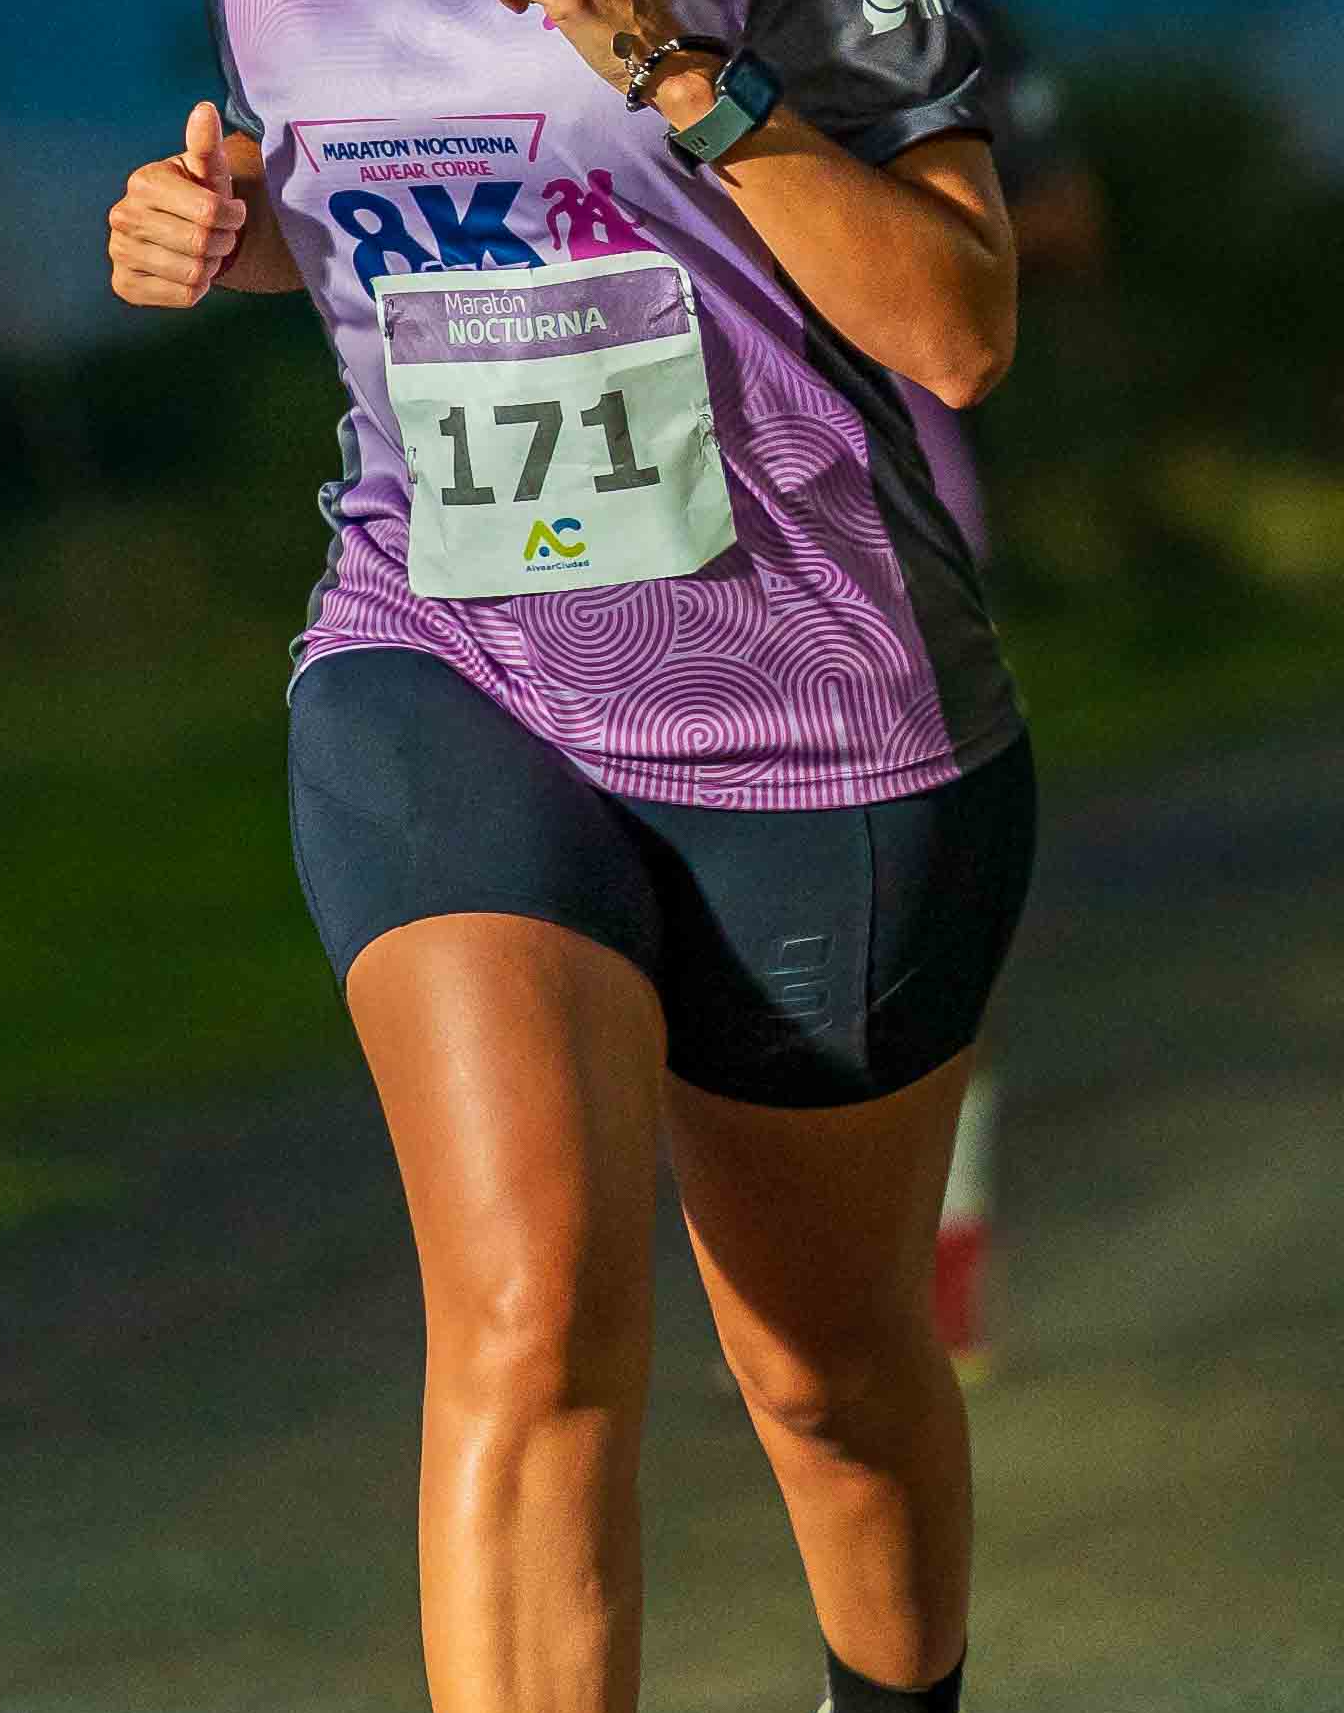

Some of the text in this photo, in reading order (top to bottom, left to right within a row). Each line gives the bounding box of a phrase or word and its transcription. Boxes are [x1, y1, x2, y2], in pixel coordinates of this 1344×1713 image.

[322, 136, 518, 162] MARATON NOCTURNA
[360, 160, 495, 183] ALVEAR CORRE
[328, 181, 547, 300] 8K
[444, 289, 526, 316] Maratón
[447, 306, 608, 346] NOCTURNA
[438, 389, 661, 506] 171
